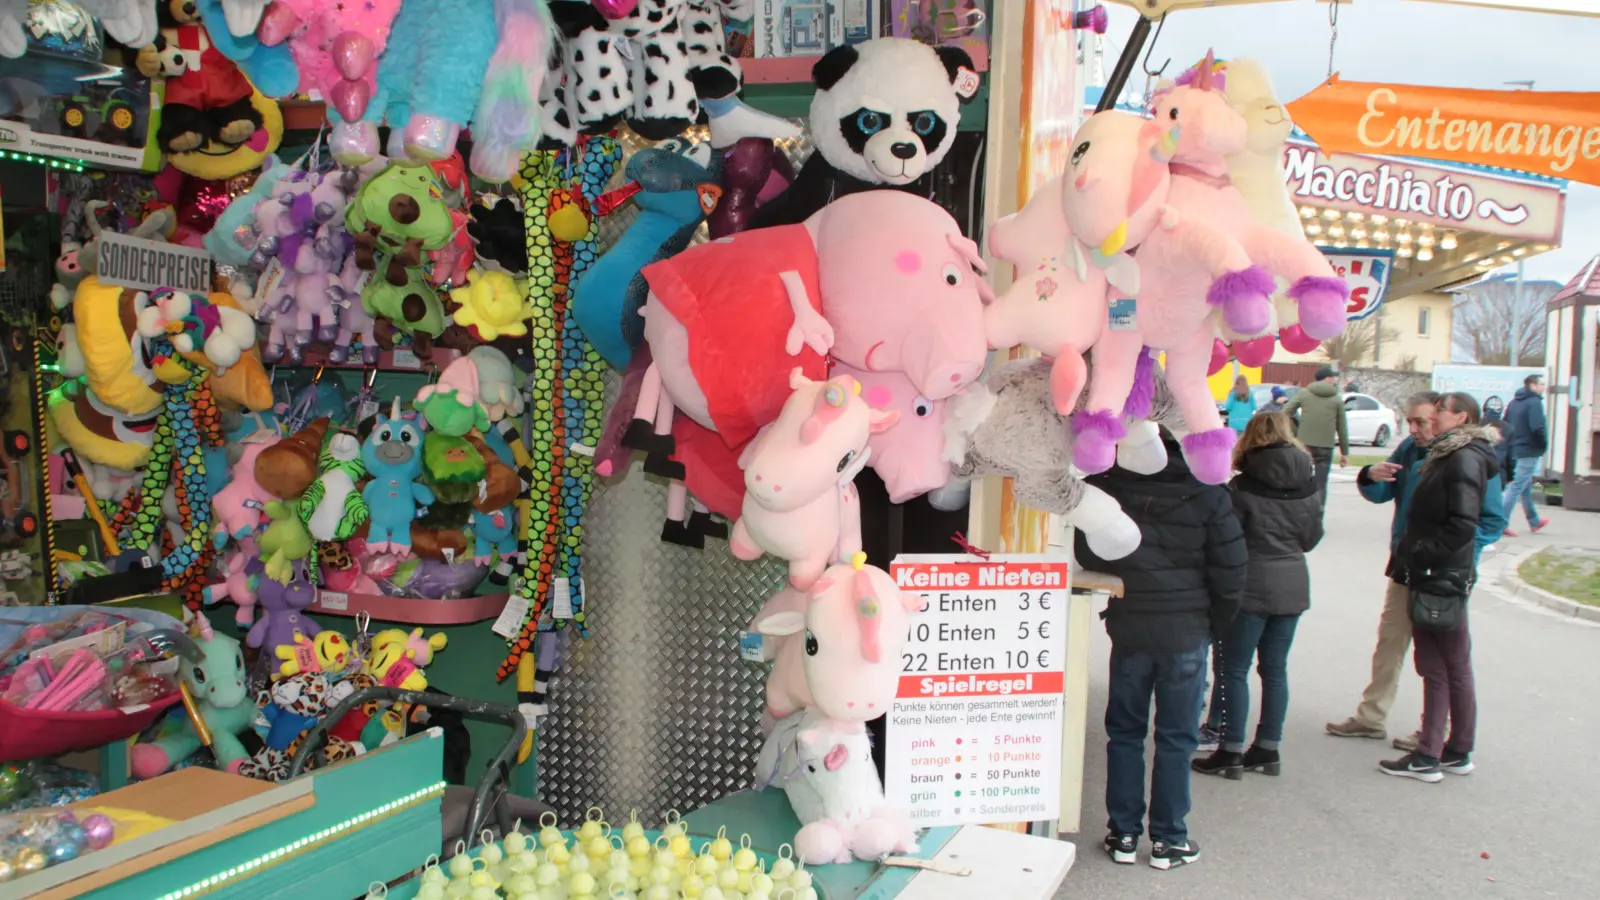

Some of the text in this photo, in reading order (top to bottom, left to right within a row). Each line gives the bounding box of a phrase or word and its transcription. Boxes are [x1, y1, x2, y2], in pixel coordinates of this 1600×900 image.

[1357, 88, 1600, 172] Entenange
[1286, 148, 1474, 220] Macchiato
[100, 241, 209, 292] SONDERPREISE
[896, 565, 1061, 587] Keine Nieten
[940, 593, 996, 612] Enten
[1018, 592, 1030, 611] 3
[1038, 591, 1052, 610] €
[939, 623, 996, 641] Enten
[1017, 621, 1029, 640] 5
[1037, 620, 1051, 639] €
[902, 650, 1050, 672] 22 Enten 10 €
[919, 673, 1033, 697] Spielregel
[892, 698, 1058, 712] Punkte können gesammelt werden!
[892, 715, 922, 725] Keine
[924, 714, 957, 724] Nieten
[966, 713, 988, 725] jede
[990, 712, 1013, 723] Ente
[1015, 711, 1056, 723] gewinnt!
[911, 738, 936, 750] pink
[994, 735, 1001, 745] 5
[1003, 734, 1042, 744] Punkte
[911, 756, 950, 767] orange
[987, 753, 1000, 762] 10
[1003, 752, 1041, 762] Punkte
[910, 773, 944, 784] braun
[987, 770, 1000, 780] 50
[1002, 769, 1041, 779] Punkte
[910, 791, 937, 803] grün
[981, 788, 999, 797] 100
[1002, 786, 1041, 796] Punkte
[910, 808, 942, 819] silber
[979, 802, 1046, 815] Sonderpreis
